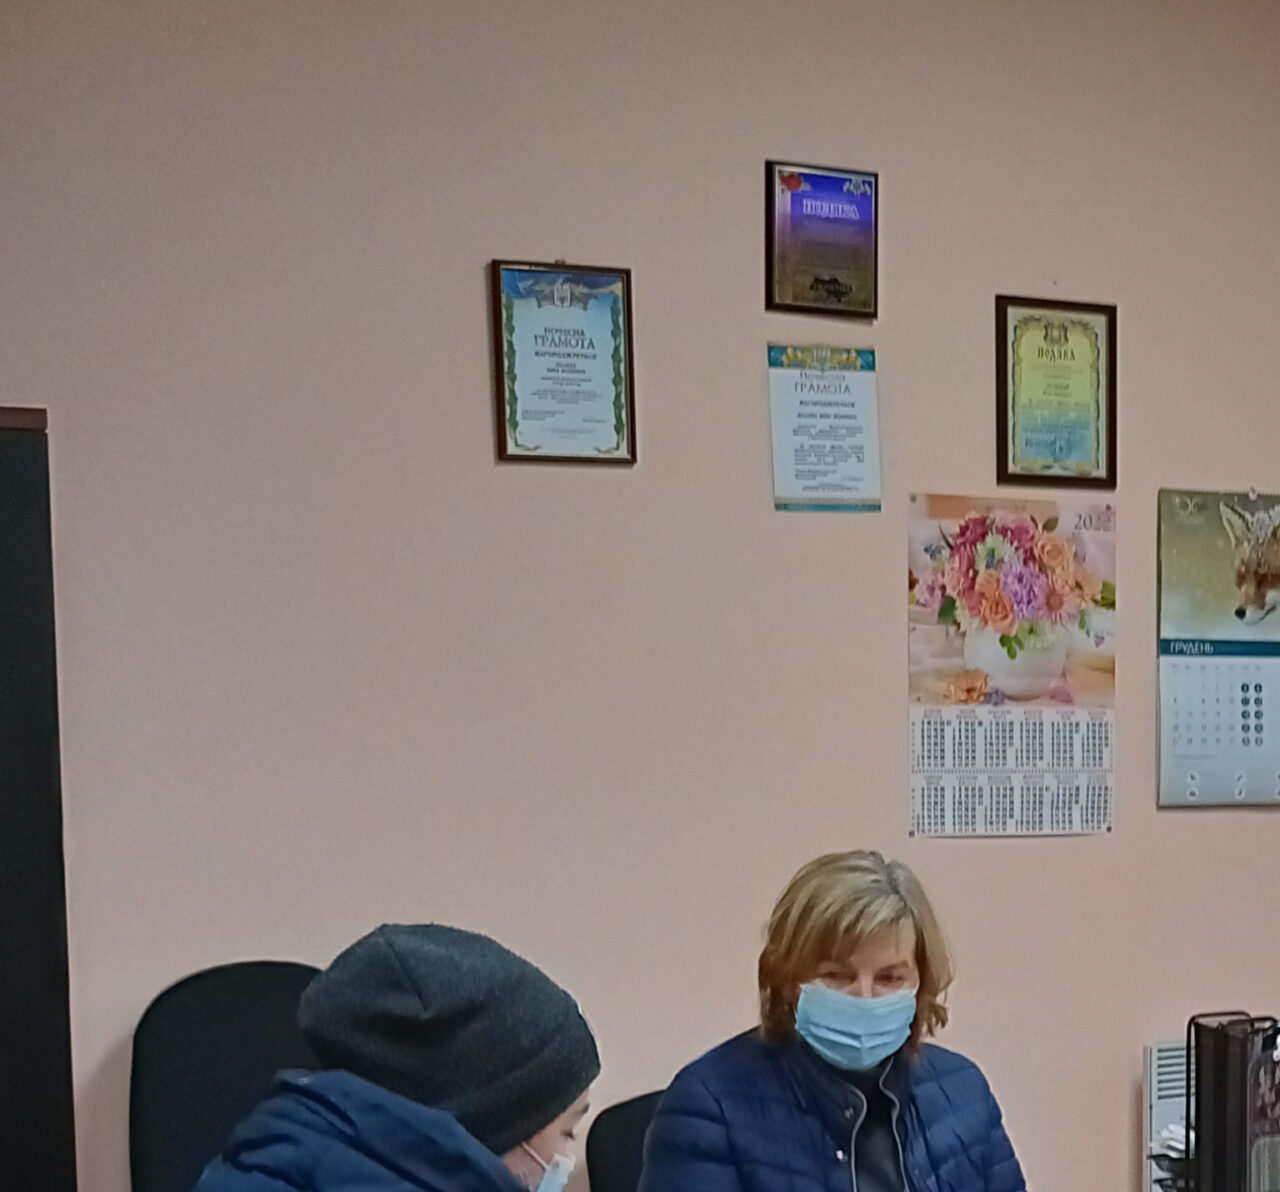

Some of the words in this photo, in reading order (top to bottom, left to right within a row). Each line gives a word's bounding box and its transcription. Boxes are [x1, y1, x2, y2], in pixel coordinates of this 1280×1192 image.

[534, 334, 596, 350] ГРАМОТА
[794, 382, 852, 395] ГРАМОТА
[1170, 641, 1214, 656] ГРУДЕНЬ
